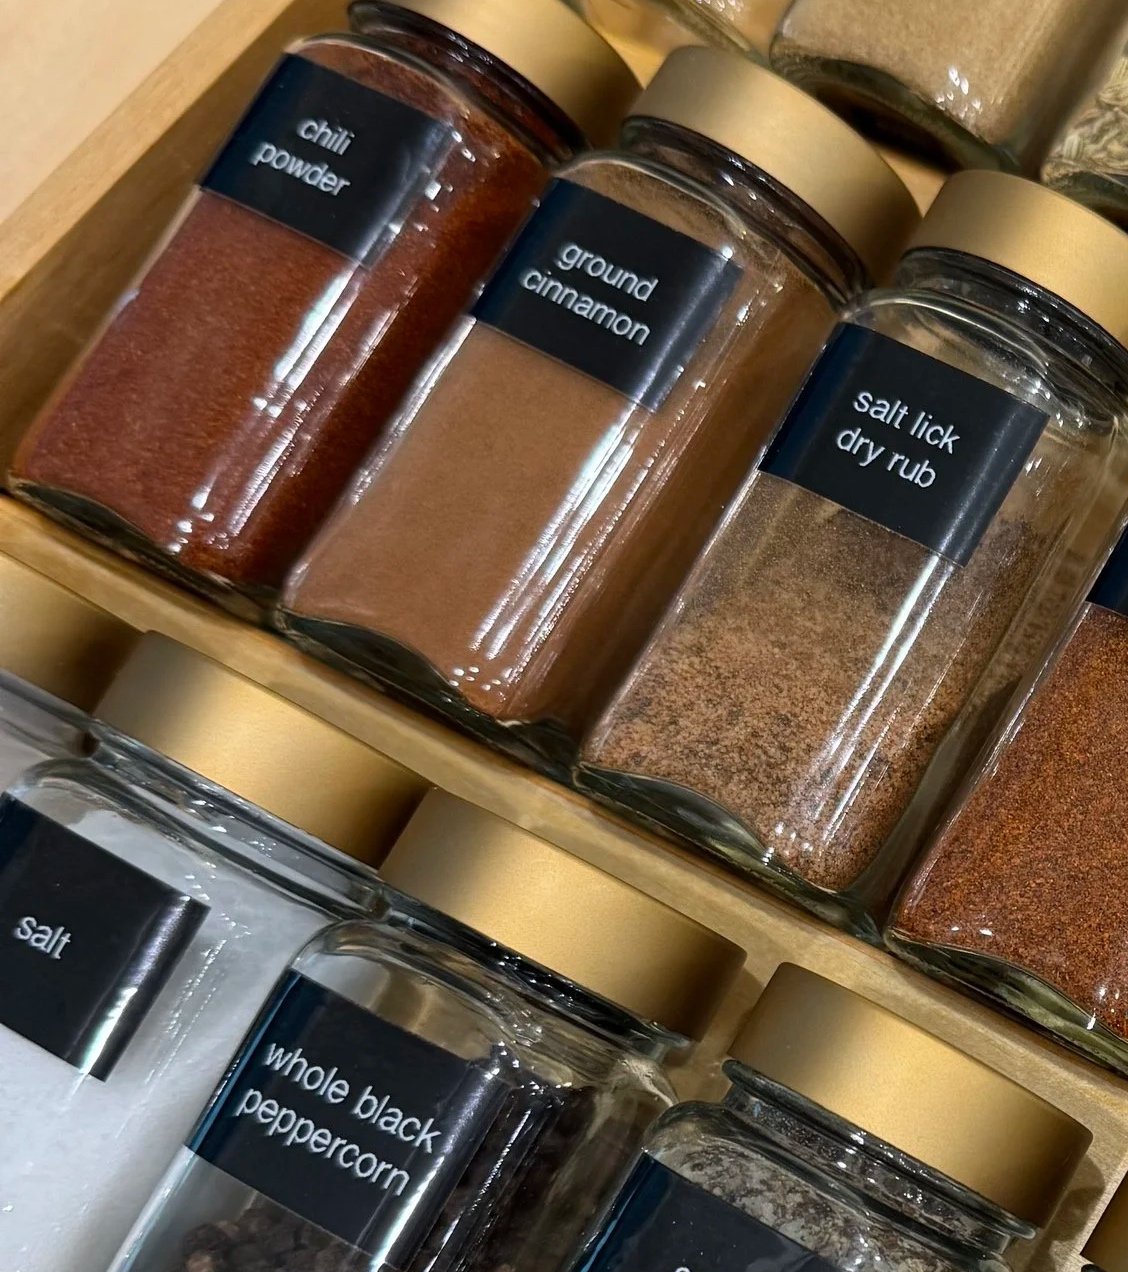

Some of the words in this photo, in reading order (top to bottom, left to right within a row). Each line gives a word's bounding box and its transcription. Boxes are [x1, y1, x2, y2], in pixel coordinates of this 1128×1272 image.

[251, 142, 351, 196] powder
[297, 119, 352, 156] chili
[556, 243, 659, 302] ground
[520, 269, 651, 346] cinnamon
[853, 386, 908, 430] salt
[909, 404, 961, 455] lick
[836, 424, 886, 467] dry
[886, 451, 936, 489] rub
[14, 912, 72, 961] salt
[263, 1042, 350, 1105] whole
[351, 1085, 442, 1154] black
[234, 1085, 410, 1196] peppercorn
